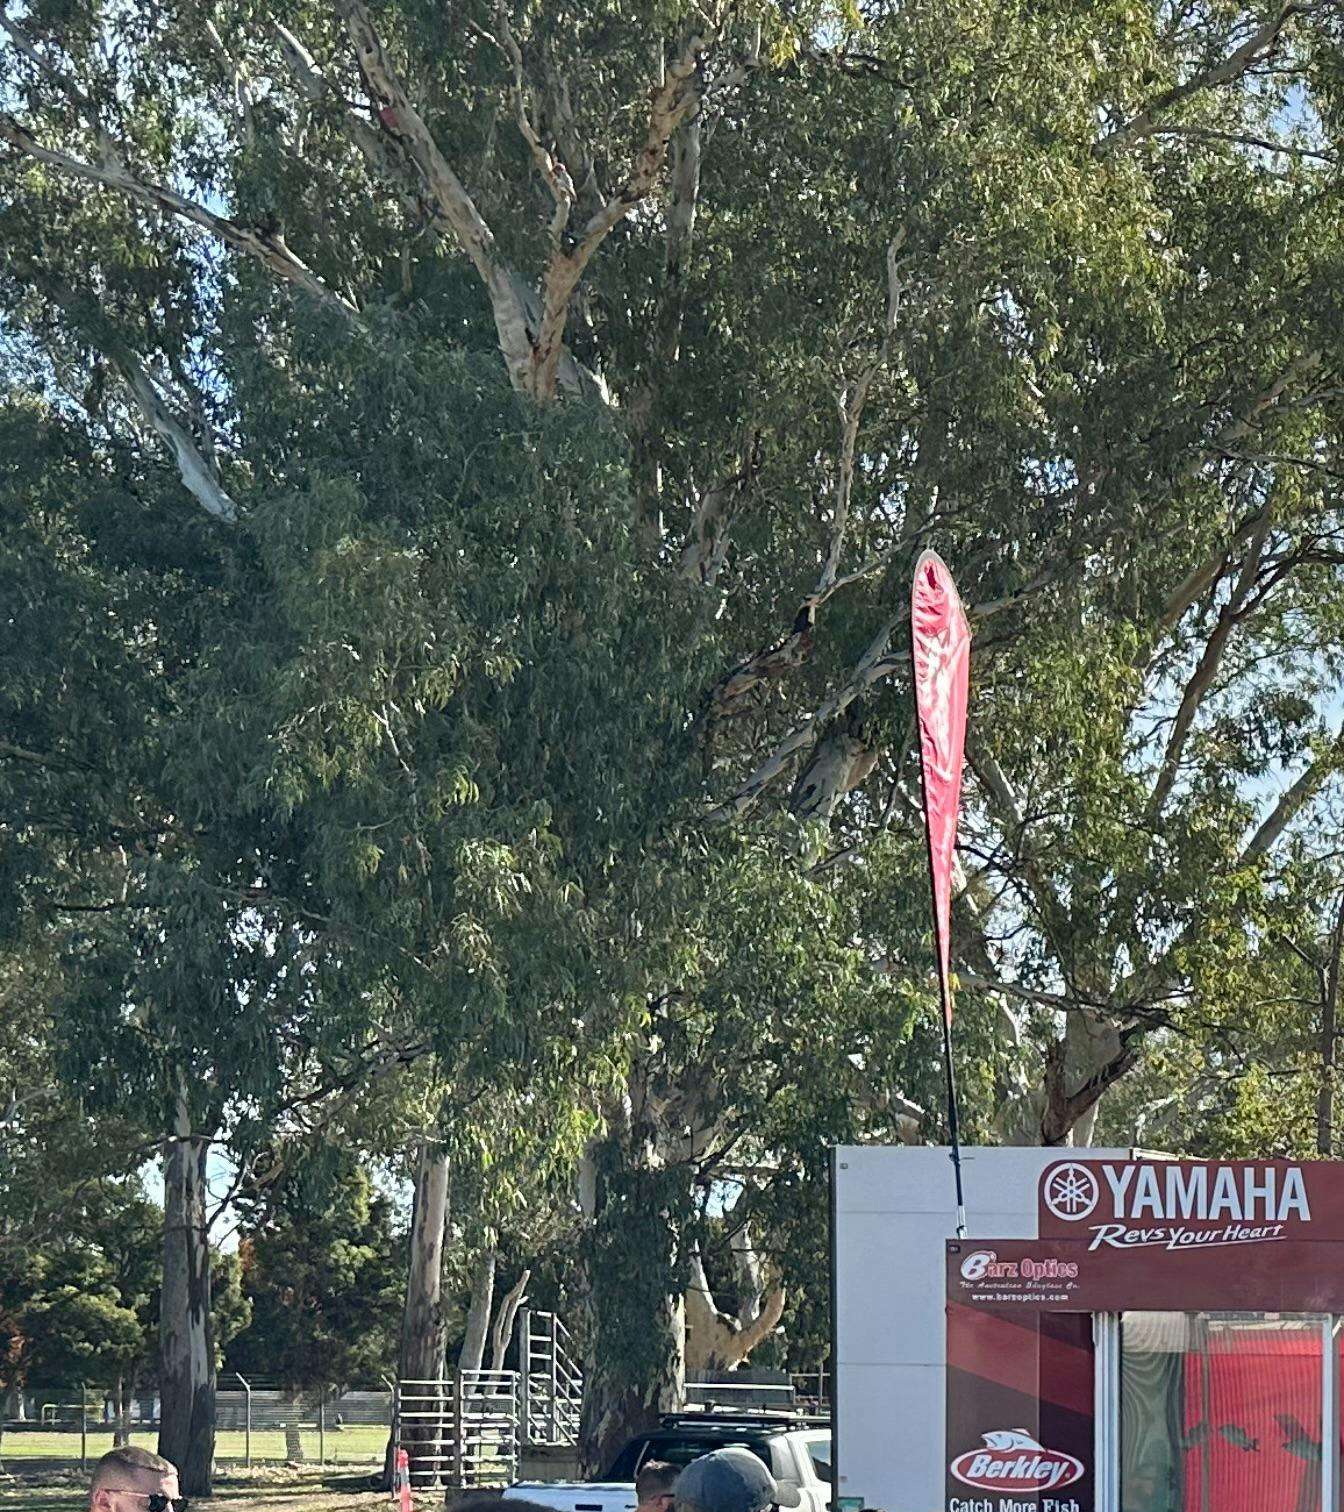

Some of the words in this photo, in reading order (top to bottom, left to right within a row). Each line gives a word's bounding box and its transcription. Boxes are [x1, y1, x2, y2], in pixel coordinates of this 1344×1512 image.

[1102, 1165, 1311, 1221] YAMAHA
[1088, 1224, 1165, 1251] Revs
[1164, 1226, 1224, 1250] Your
[1223, 1224, 1285, 1241] Heart
[1020, 1258, 1079, 1281] Optics
[967, 1454, 1071, 1488] Berkley
